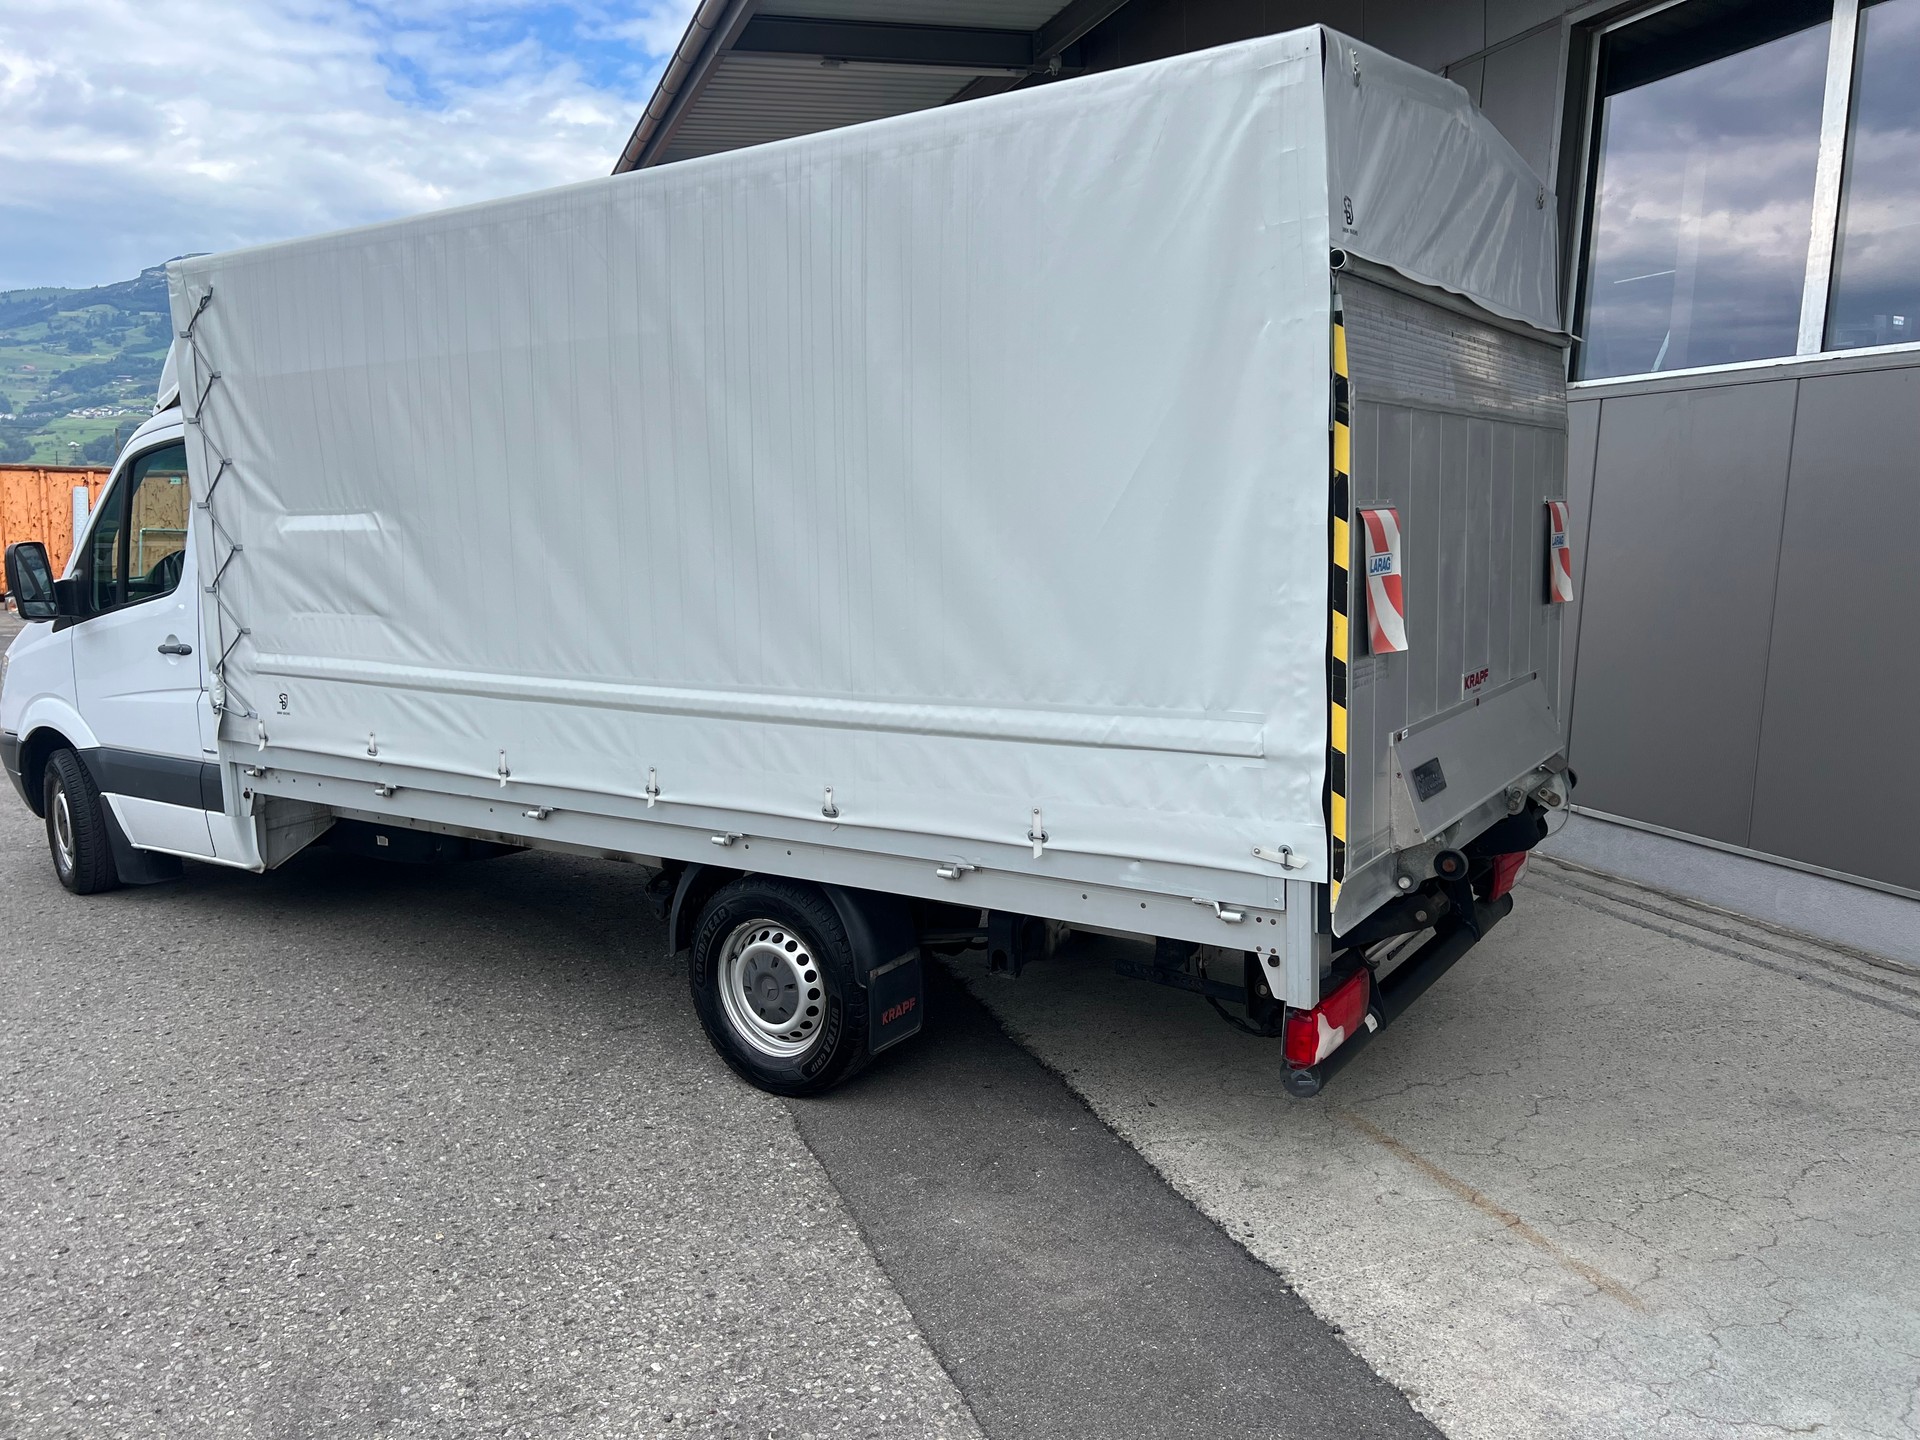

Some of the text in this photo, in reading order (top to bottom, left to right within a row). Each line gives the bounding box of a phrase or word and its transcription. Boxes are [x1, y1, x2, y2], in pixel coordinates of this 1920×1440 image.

[1370, 556, 1391, 573] LARAG
[1464, 668, 1489, 690] KRAPF
[696, 908, 727, 983] GOODYEAR
[882, 997, 916, 1026] KRAPF
[811, 1008, 840, 1073] ULTRA GRIP
